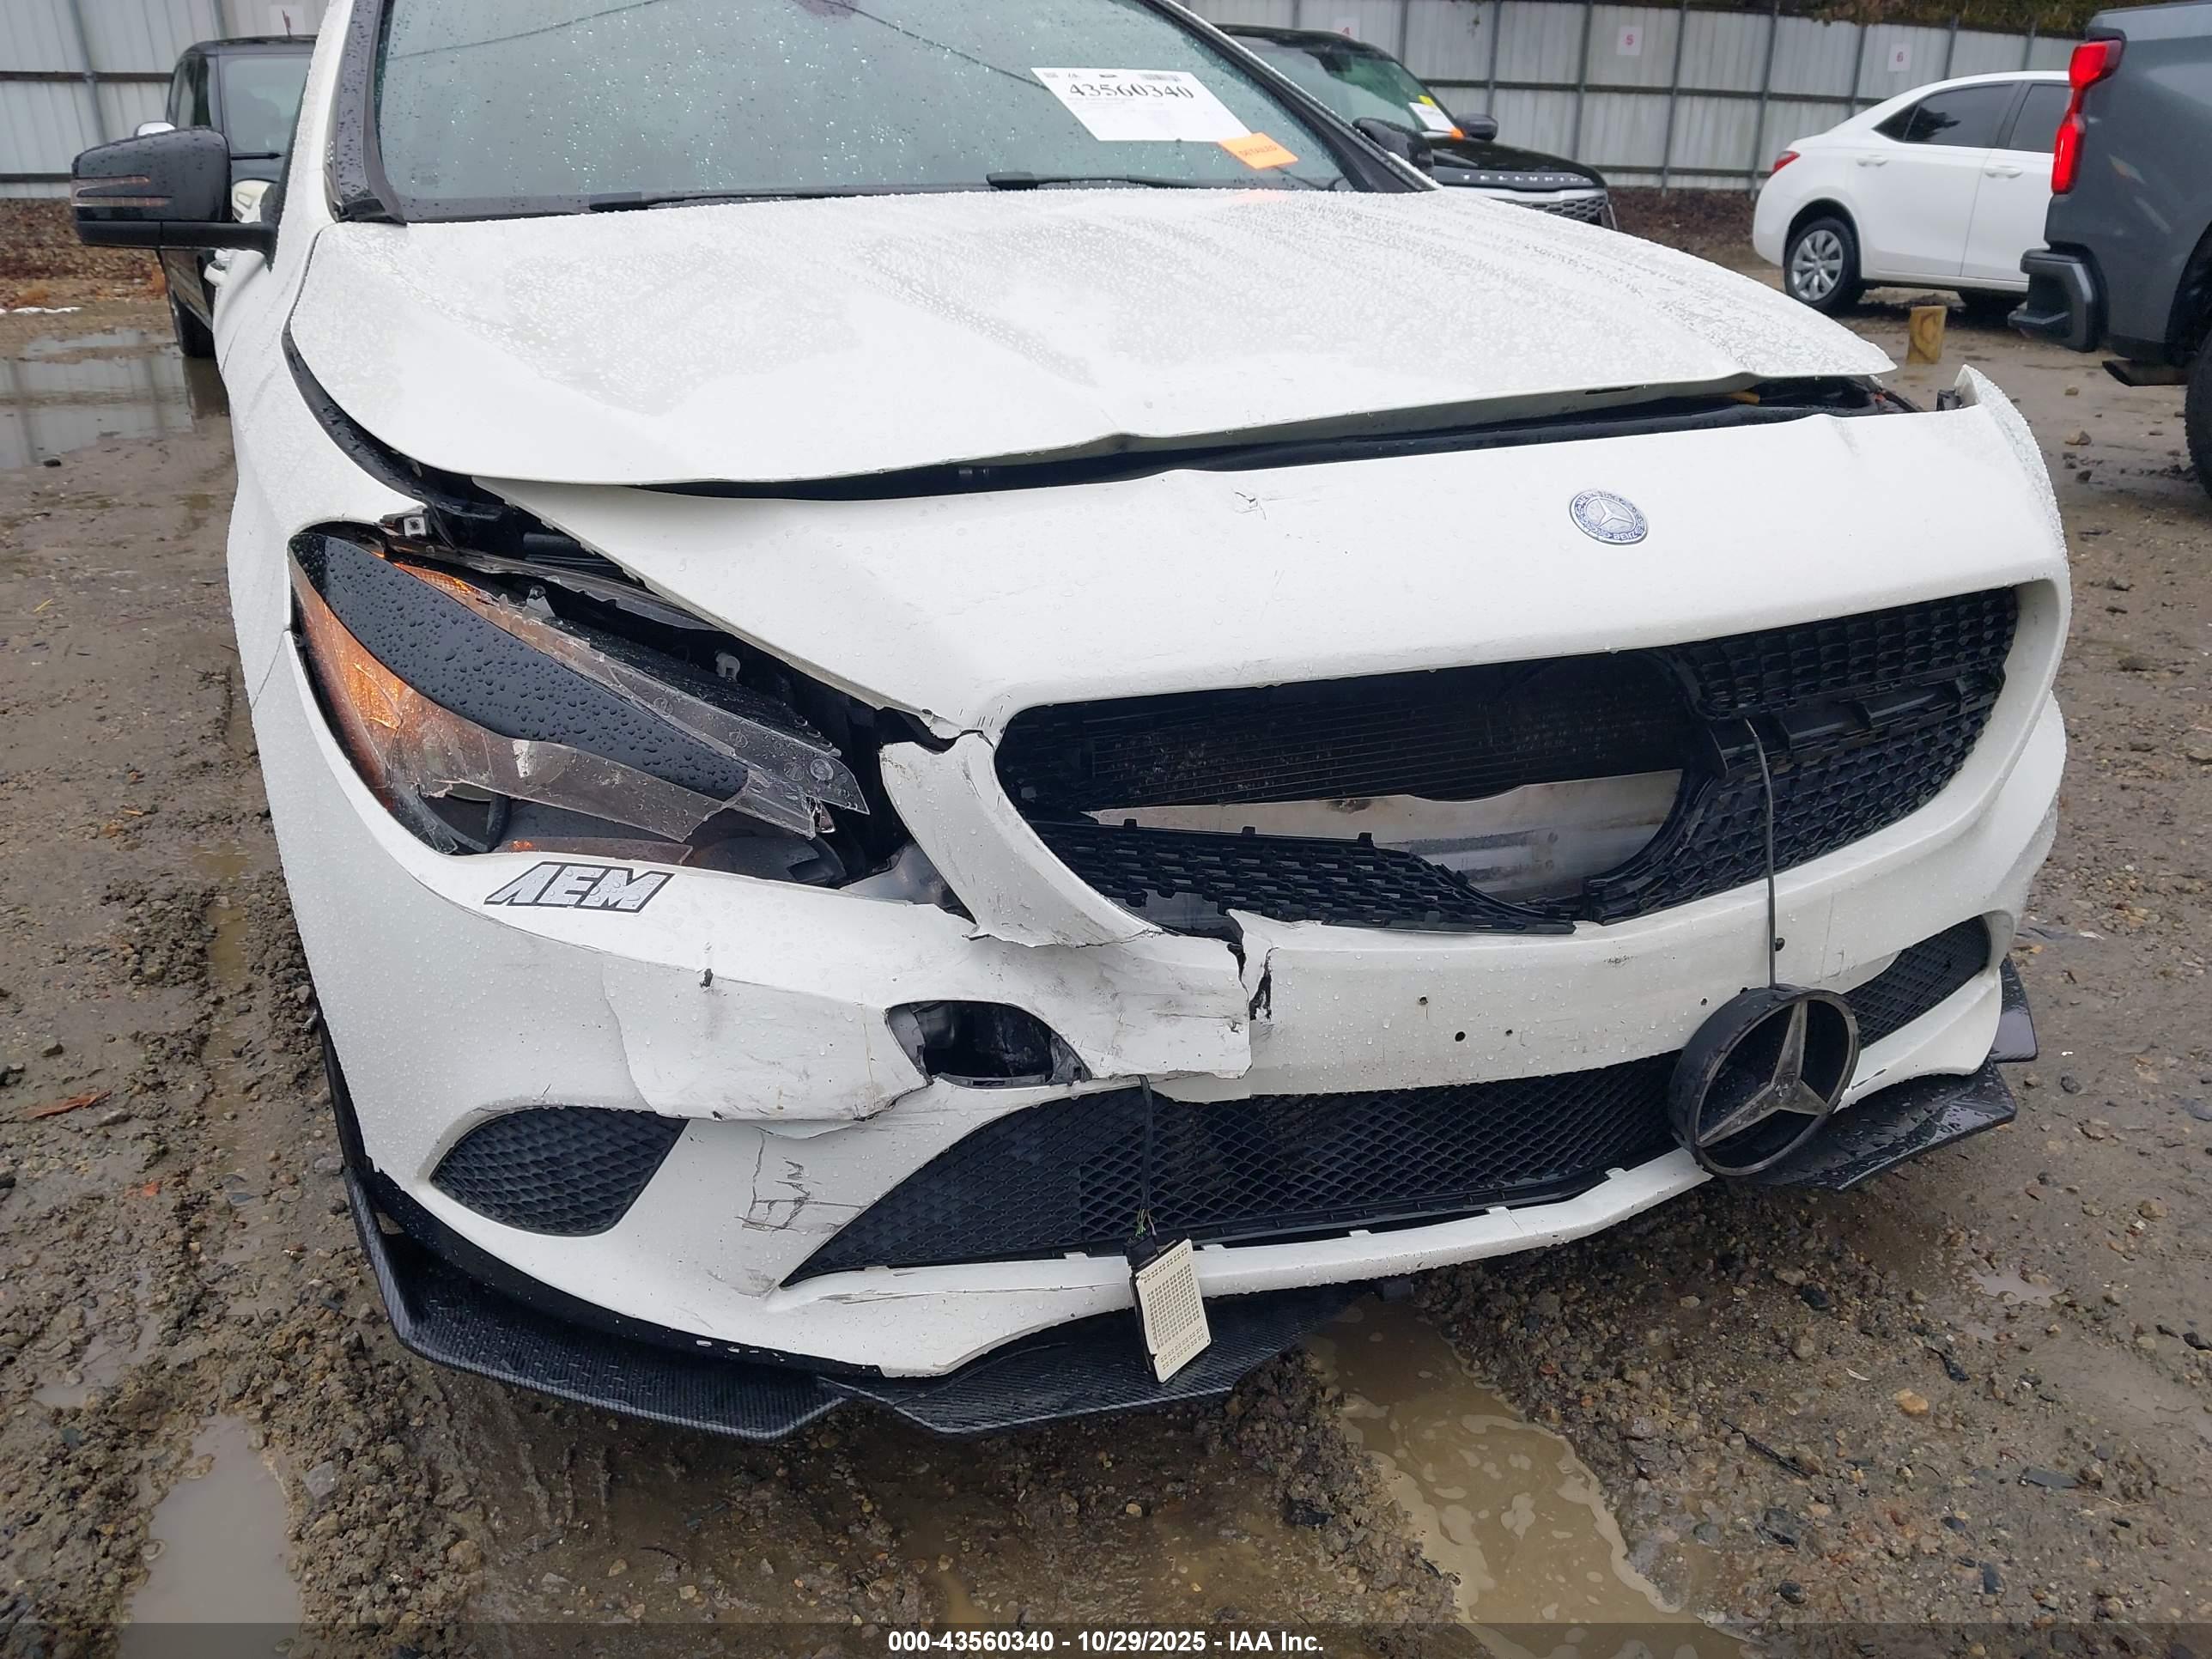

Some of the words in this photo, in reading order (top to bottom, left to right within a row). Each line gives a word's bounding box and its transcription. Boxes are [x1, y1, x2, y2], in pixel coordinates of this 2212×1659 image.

[1626, 33, 1634, 46] 5
[1070, 83, 1194, 100] 43560340
[483, 861, 675, 913] AEM
